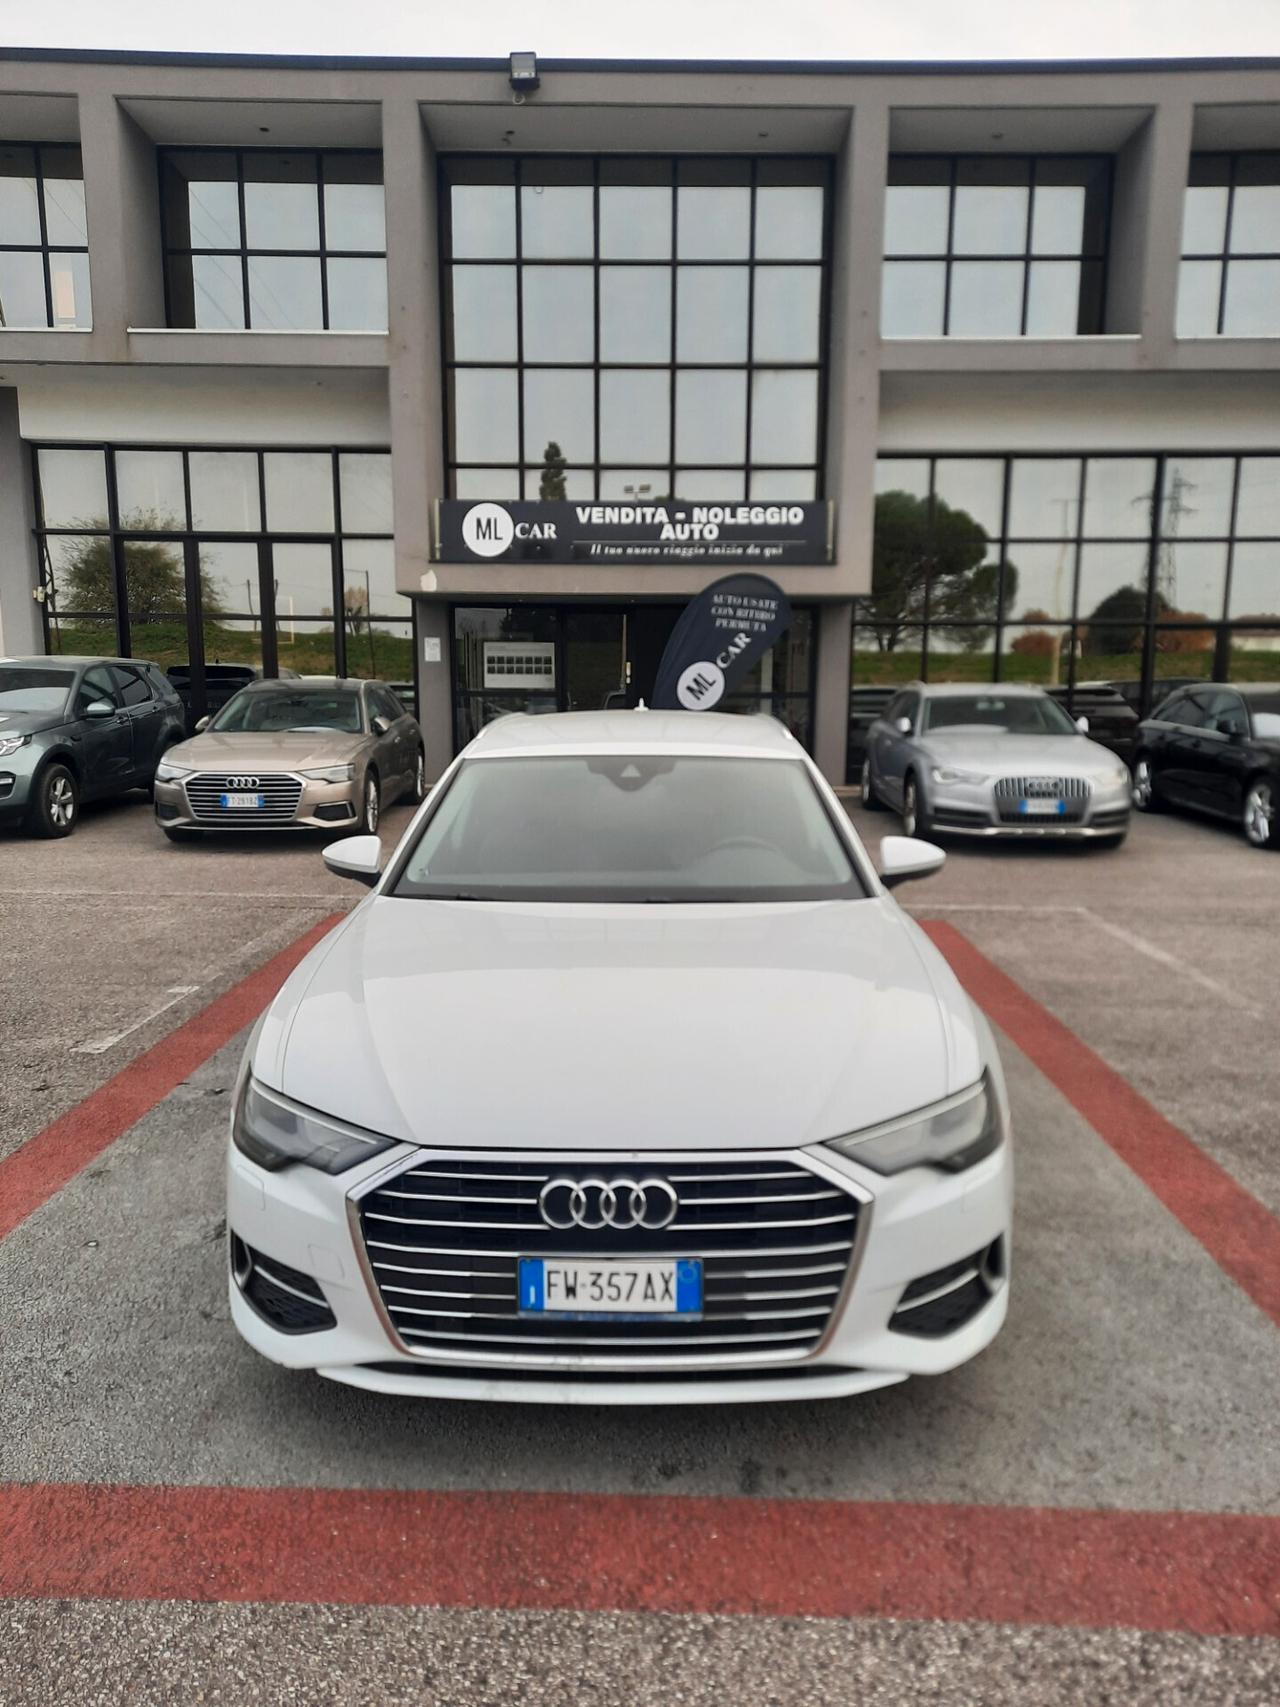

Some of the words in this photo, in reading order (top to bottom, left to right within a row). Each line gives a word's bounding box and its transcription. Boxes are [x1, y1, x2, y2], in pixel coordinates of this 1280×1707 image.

[576, 506, 670, 525] VENDITA
[692, 506, 805, 526] NOLEGGIO
[475, 517, 503, 541] ML
[514, 522, 557, 540] CAR
[659, 523, 719, 541] AUTO
[604, 545, 623, 555] tuo
[708, 544, 743, 555] inizia
[745, 545, 761, 555] da
[763, 544, 783, 558] qui
[685, 673, 717, 701] ML
[716, 632, 752, 669] CAR
